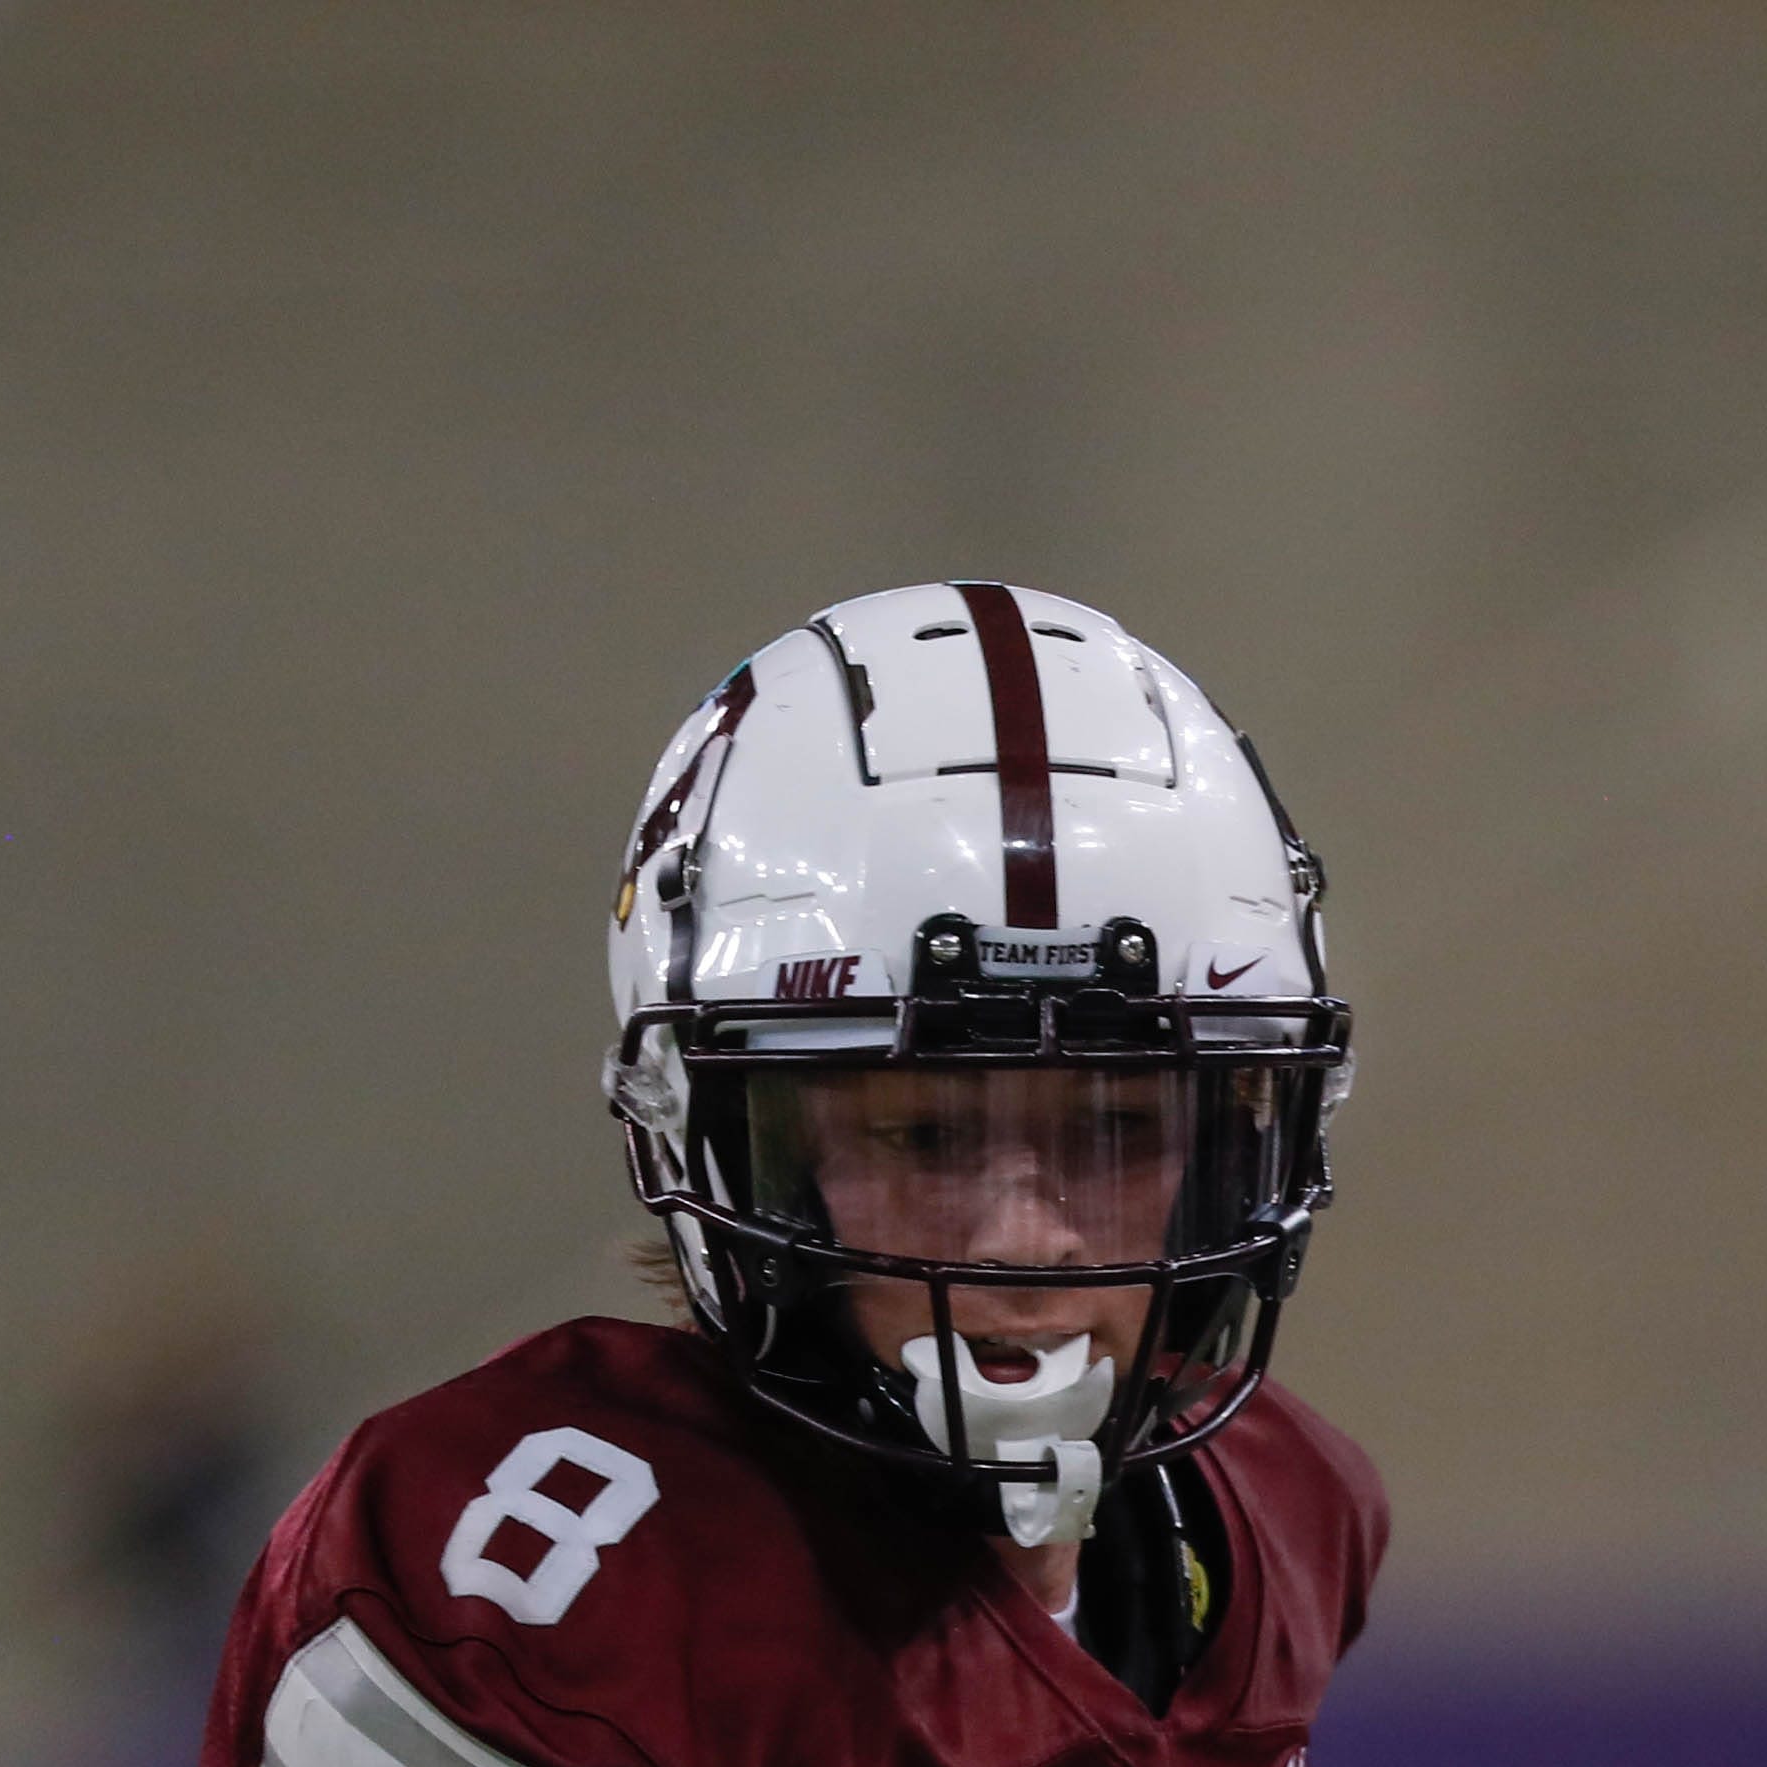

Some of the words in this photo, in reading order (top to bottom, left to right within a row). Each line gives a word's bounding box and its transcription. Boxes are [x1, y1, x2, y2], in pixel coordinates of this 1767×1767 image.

[979, 940, 1034, 964] TEAM
[1045, 942, 1101, 965] FIRST
[775, 954, 861, 999] NIKE
[440, 1425, 661, 1626] 8
